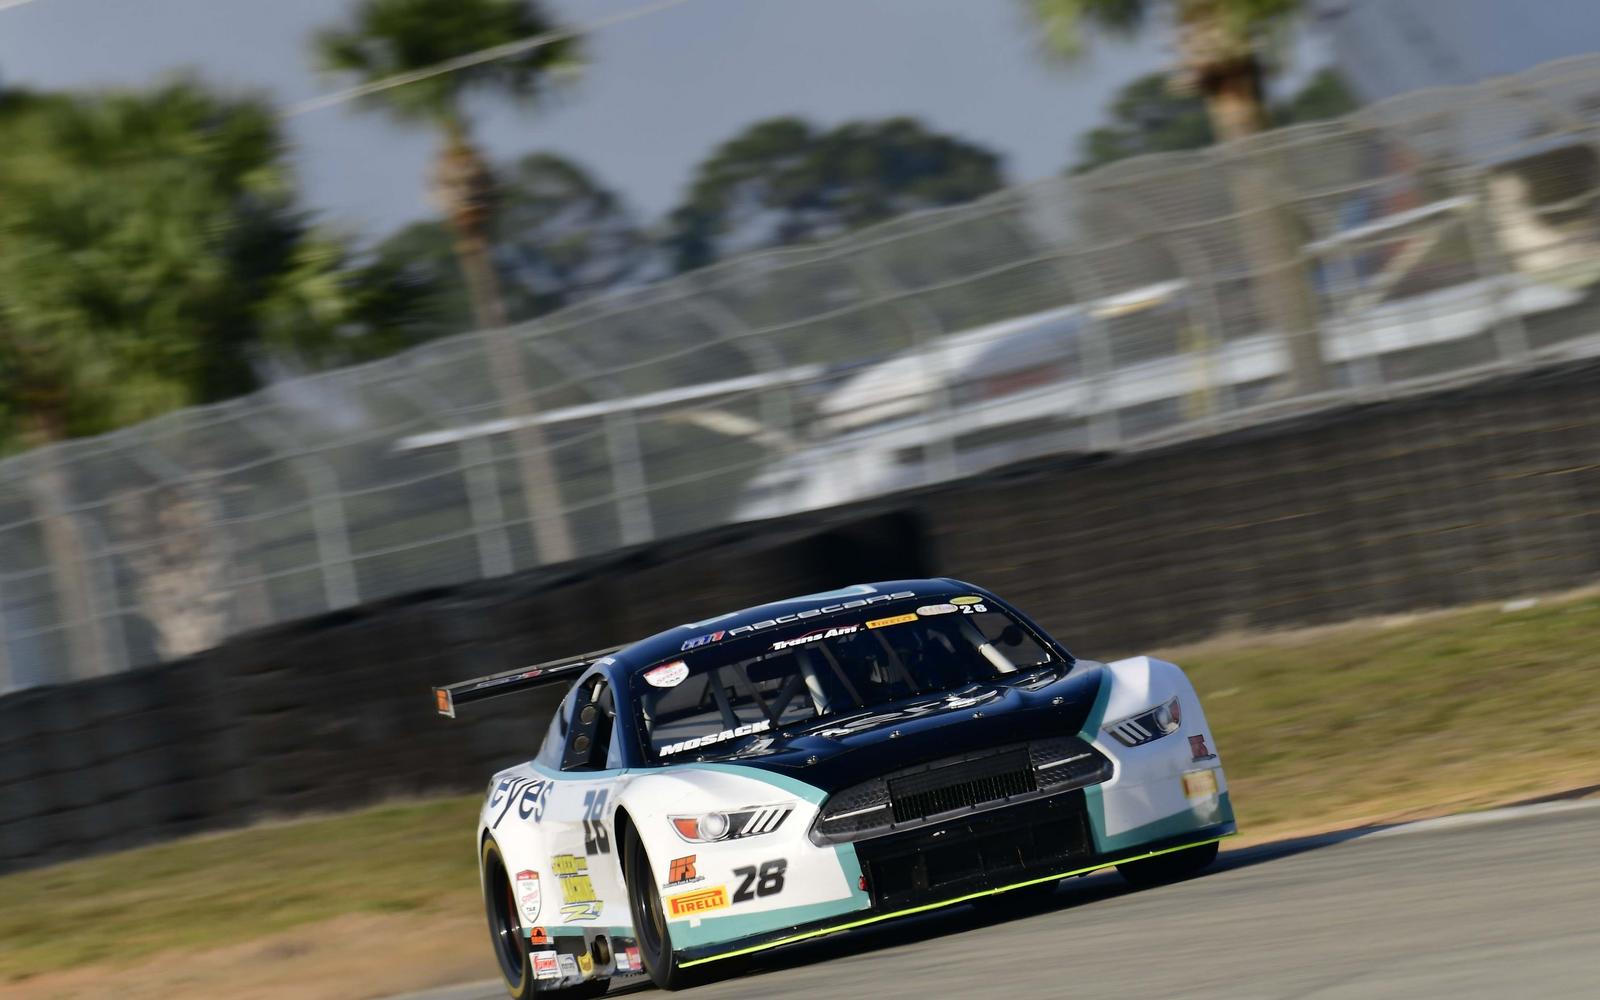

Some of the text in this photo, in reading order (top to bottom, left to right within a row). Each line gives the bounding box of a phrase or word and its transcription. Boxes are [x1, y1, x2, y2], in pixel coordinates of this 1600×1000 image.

[959, 603, 988, 615] 28
[772, 625, 858, 651] Trans Am
[659, 719, 771, 757] MOSACK
[490, 776, 555, 830] eyes
[731, 857, 788, 906] 28
[670, 889, 725, 915] PIRELLI
